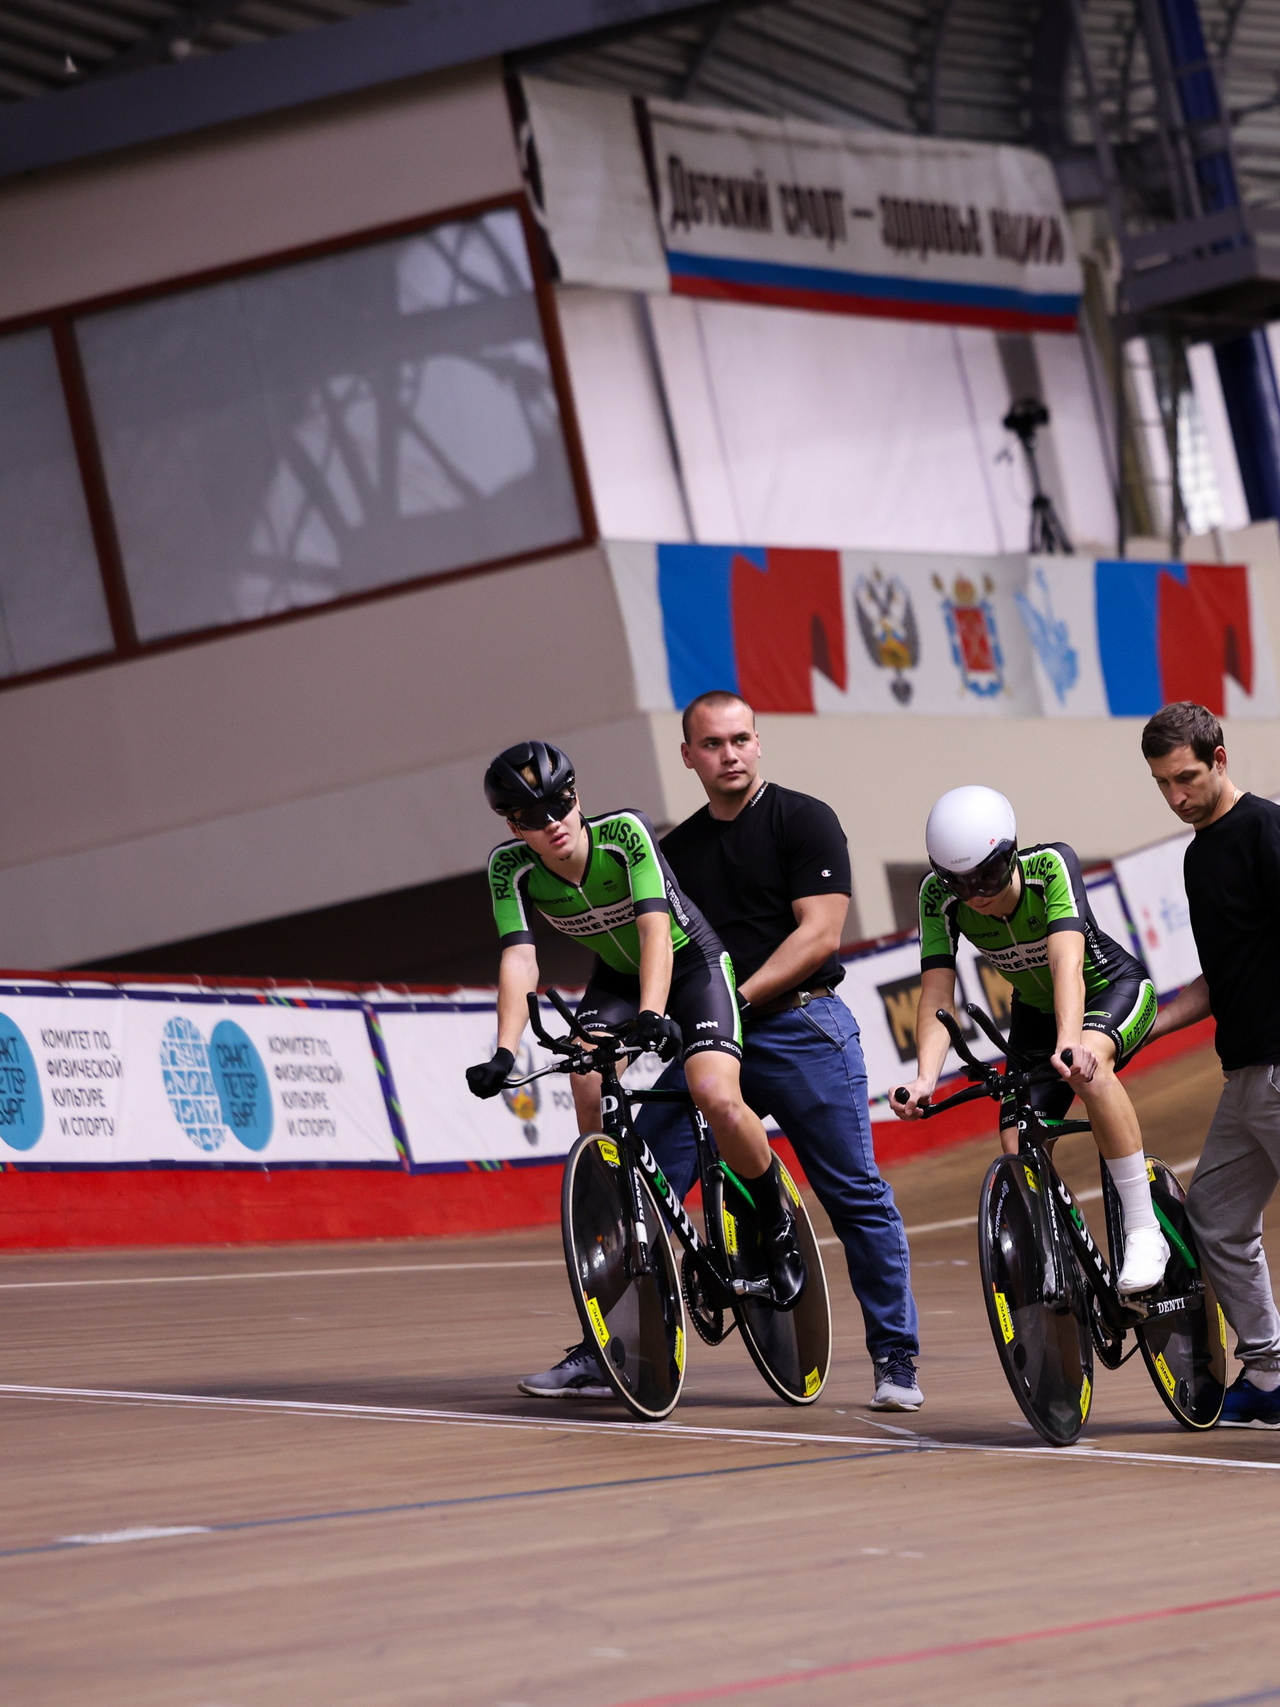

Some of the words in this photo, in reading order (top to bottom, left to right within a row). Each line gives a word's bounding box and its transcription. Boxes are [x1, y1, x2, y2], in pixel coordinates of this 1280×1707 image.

[598, 821, 648, 868] RUSSIA
[494, 846, 536, 900] RUSSIA
[551, 914, 597, 927] RUSSIA
[40, 1028, 91, 1050] КОМИТЕТ
[92, 1030, 112, 1050] ПО
[46, 1053, 124, 1079] ФИЗИЧЕСКОЙ
[51, 1087, 107, 1108] КУЛЬТУРЕ
[59, 1116, 70, 1136] И
[71, 1116, 115, 1137] СПОРТУ
[1157, 1297, 1186, 1315] DENTI
